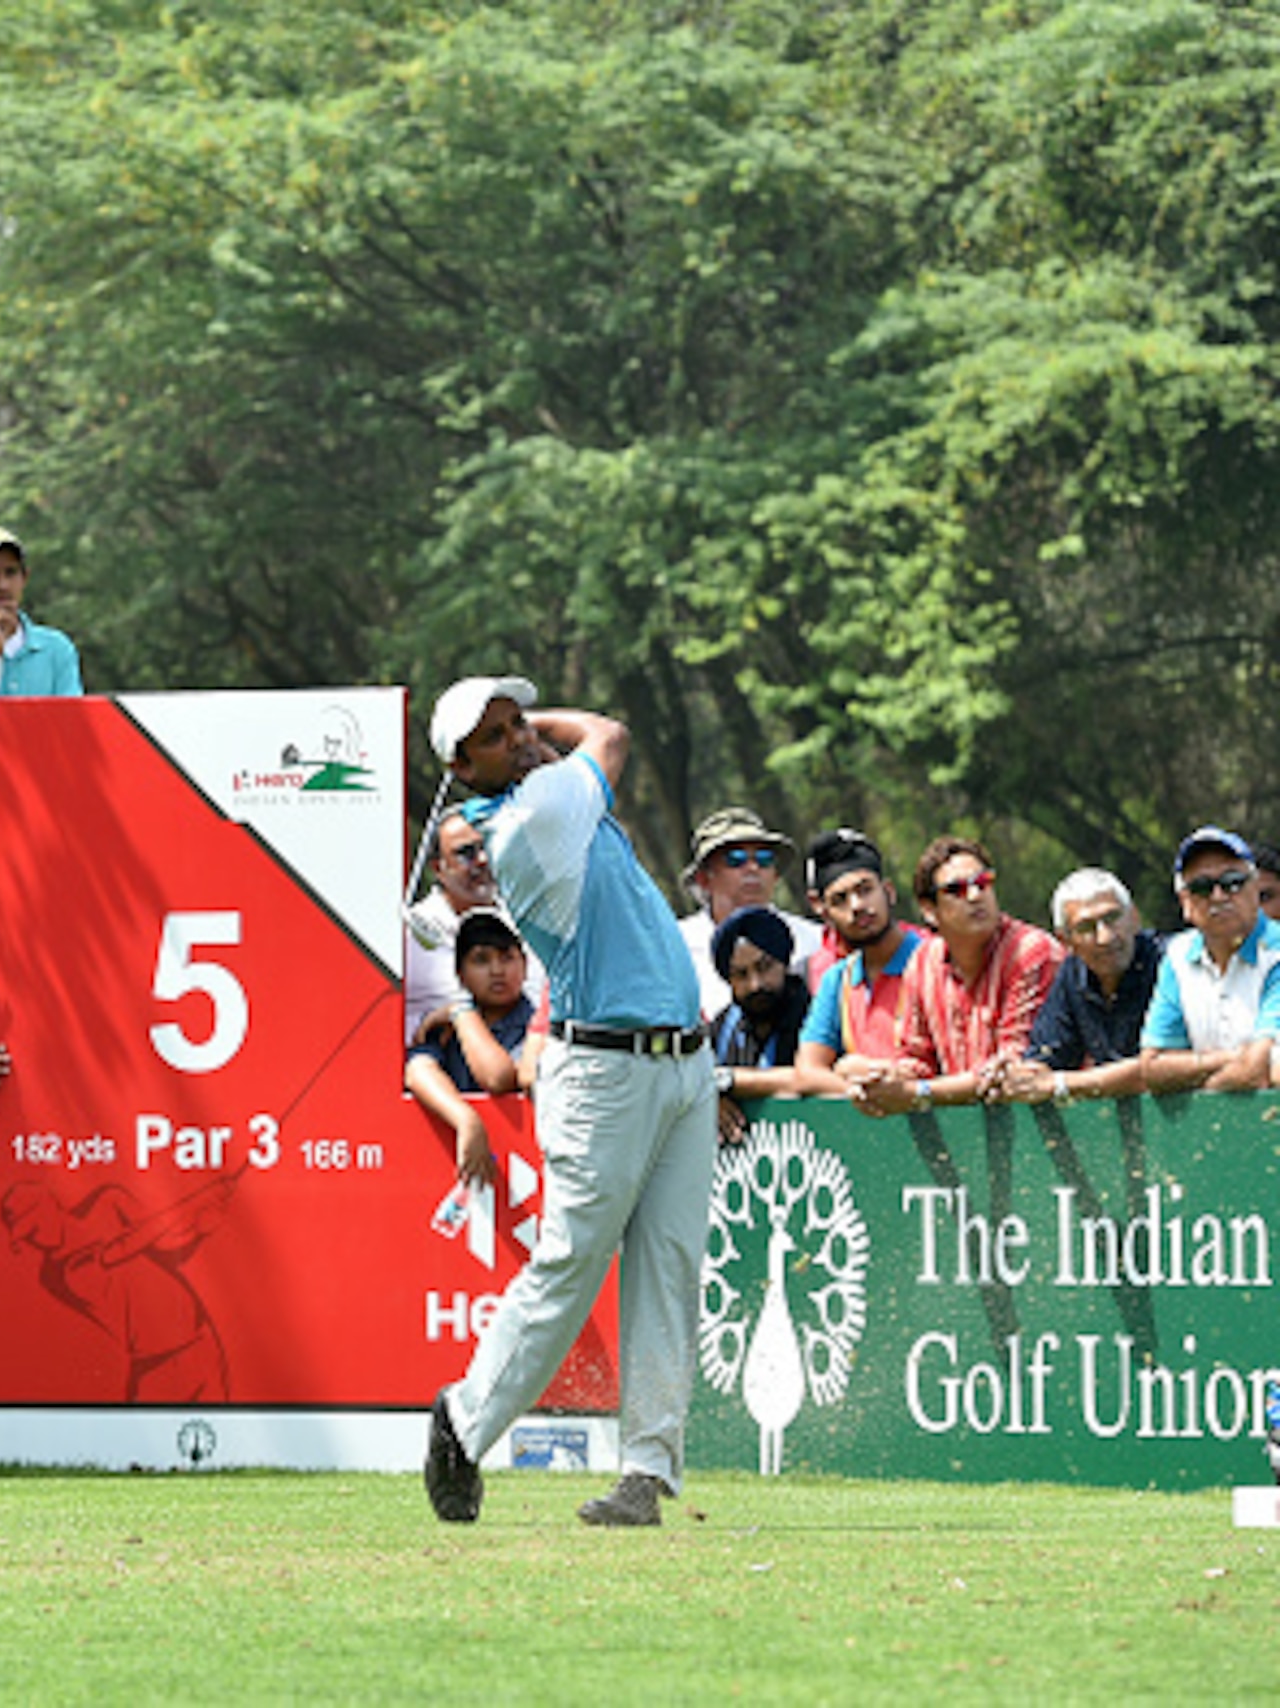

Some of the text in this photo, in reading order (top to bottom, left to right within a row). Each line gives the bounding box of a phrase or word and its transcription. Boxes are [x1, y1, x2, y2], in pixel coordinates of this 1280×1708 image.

[149, 910, 249, 1073] 5
[11, 1113, 384, 1170] 182 yds Par 3 166 m
[902, 1184, 1273, 1287] The Indian
[425, 1291, 504, 1342] He
[906, 1332, 1061, 1433] Golf
